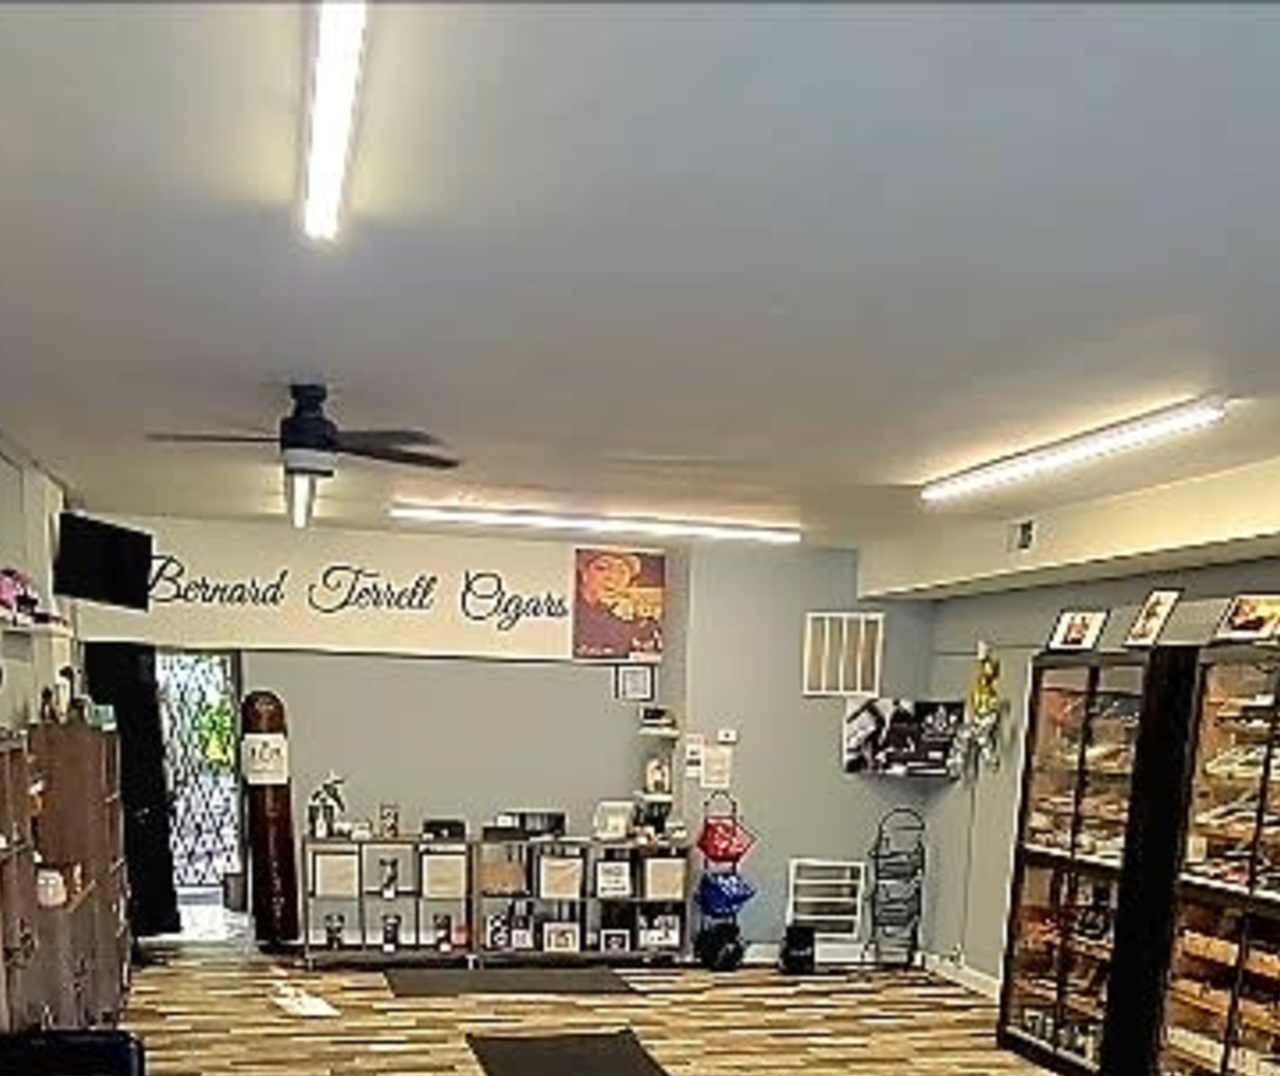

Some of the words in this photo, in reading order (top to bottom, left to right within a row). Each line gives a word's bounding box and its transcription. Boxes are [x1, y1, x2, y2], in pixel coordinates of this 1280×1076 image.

[148, 556, 288, 606] Bernard
[308, 566, 437, 614] Terrell
[461, 569, 569, 631] Cigars
